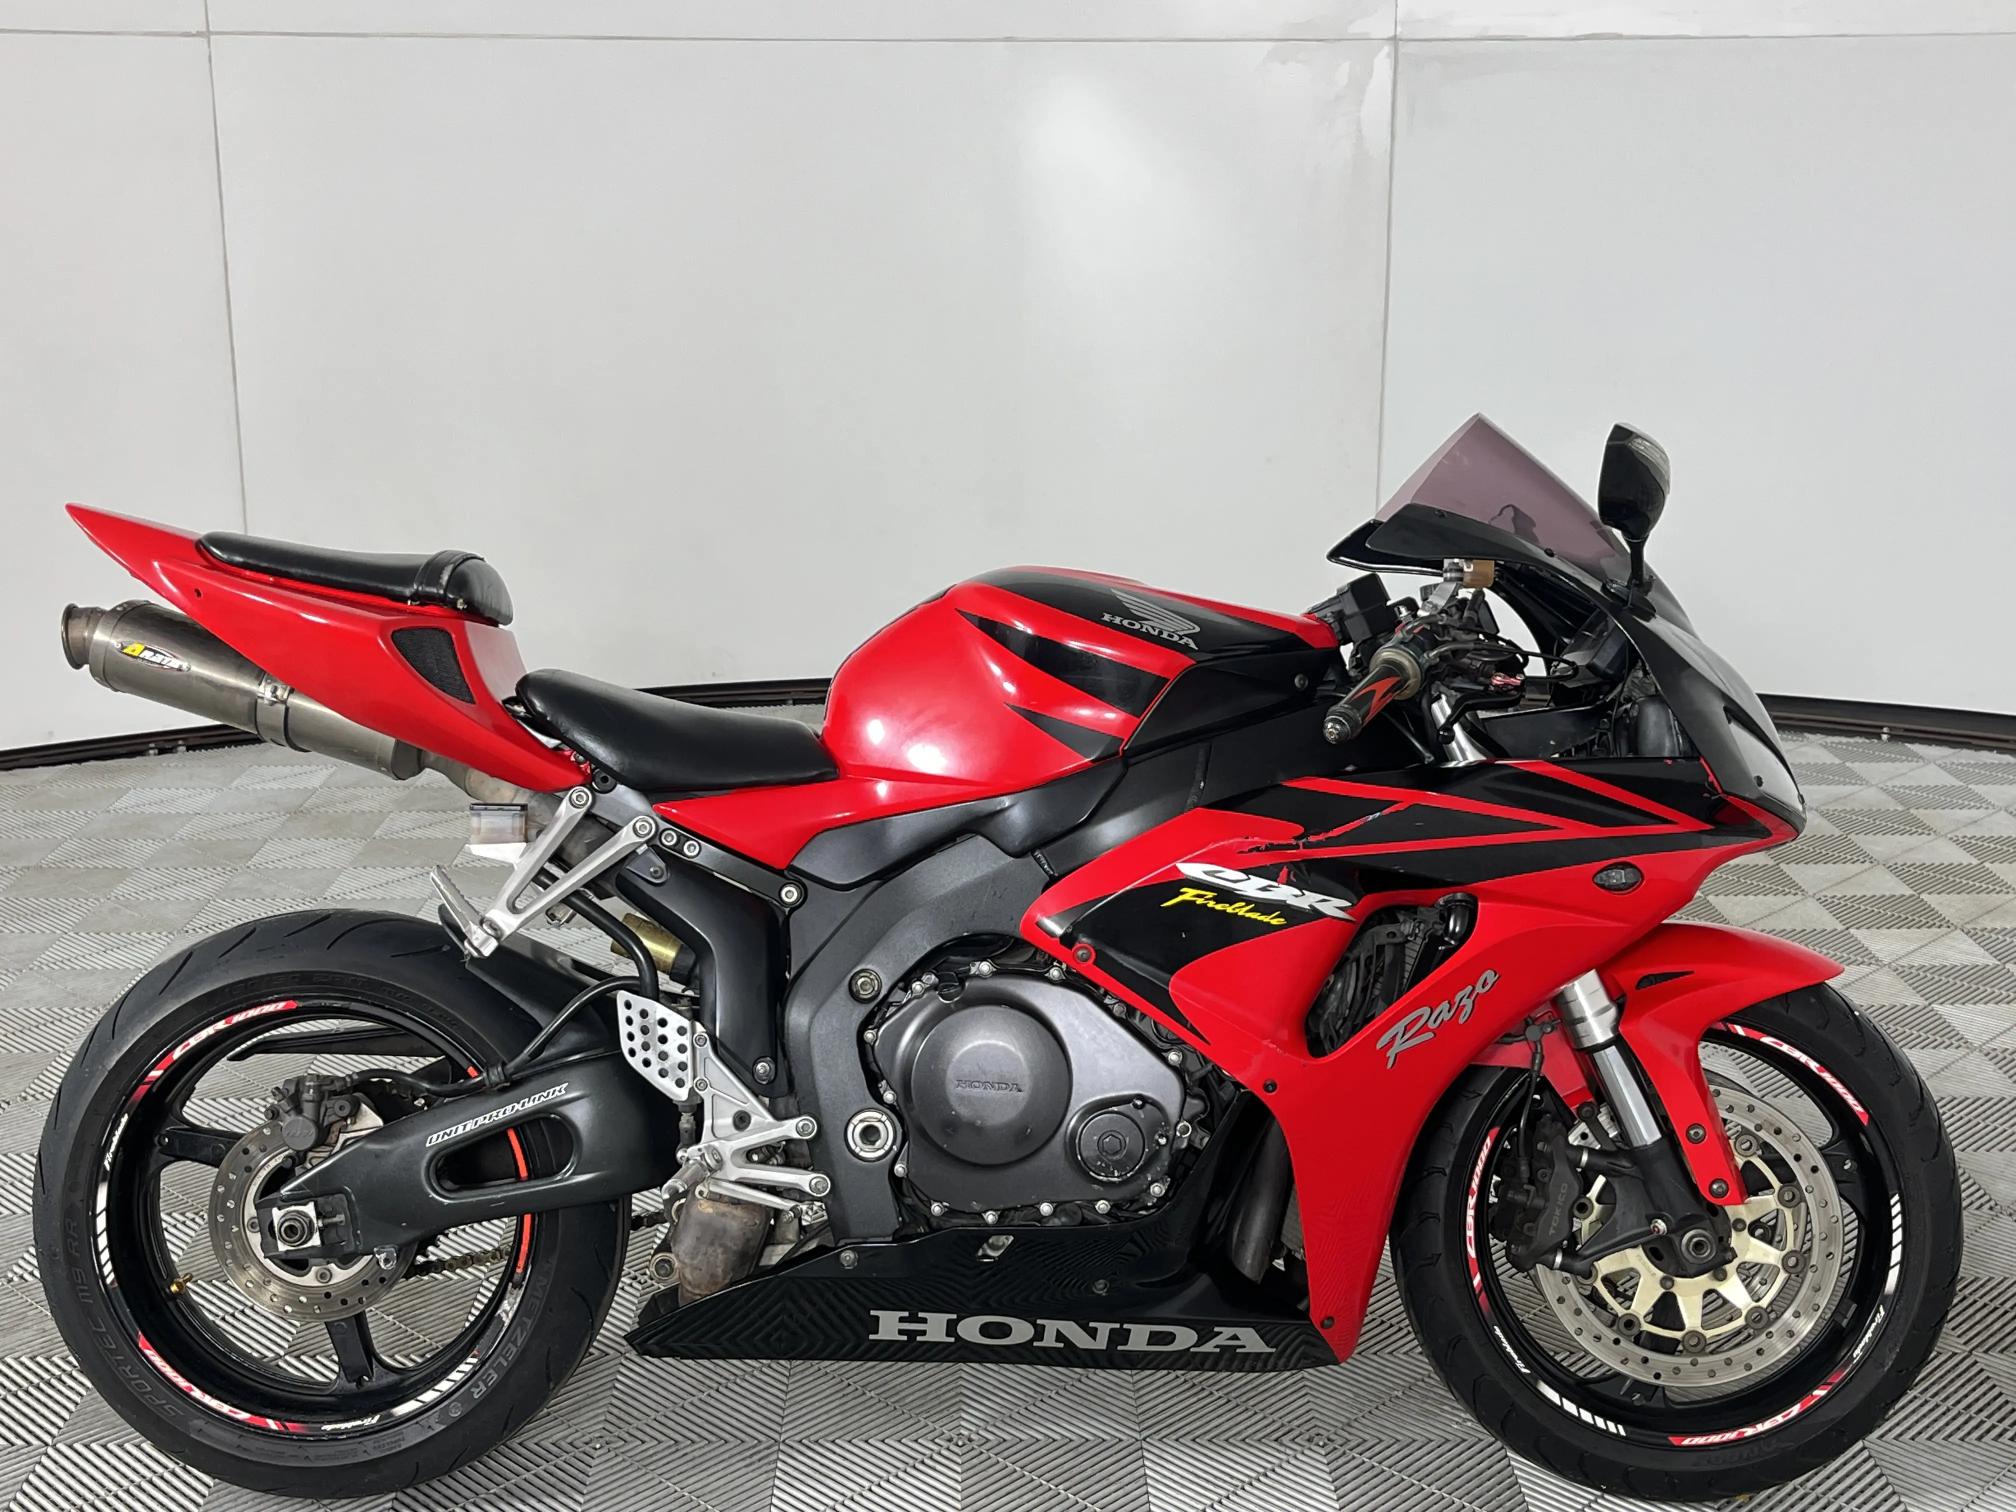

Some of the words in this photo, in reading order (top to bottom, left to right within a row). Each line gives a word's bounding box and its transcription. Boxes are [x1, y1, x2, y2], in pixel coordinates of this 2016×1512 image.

[1101, 612, 1199, 650] HONDA
[1160, 887, 1287, 925] Fireblade
[1176, 862, 1356, 921] CBR
[1376, 969, 1499, 1070] Razo
[956, 1079, 1024, 1093] HONDA
[470, 1273, 550, 1399] METZELER
[868, 1309, 1277, 1354] HONDA
[87, 1319, 185, 1419] SPORTEC
